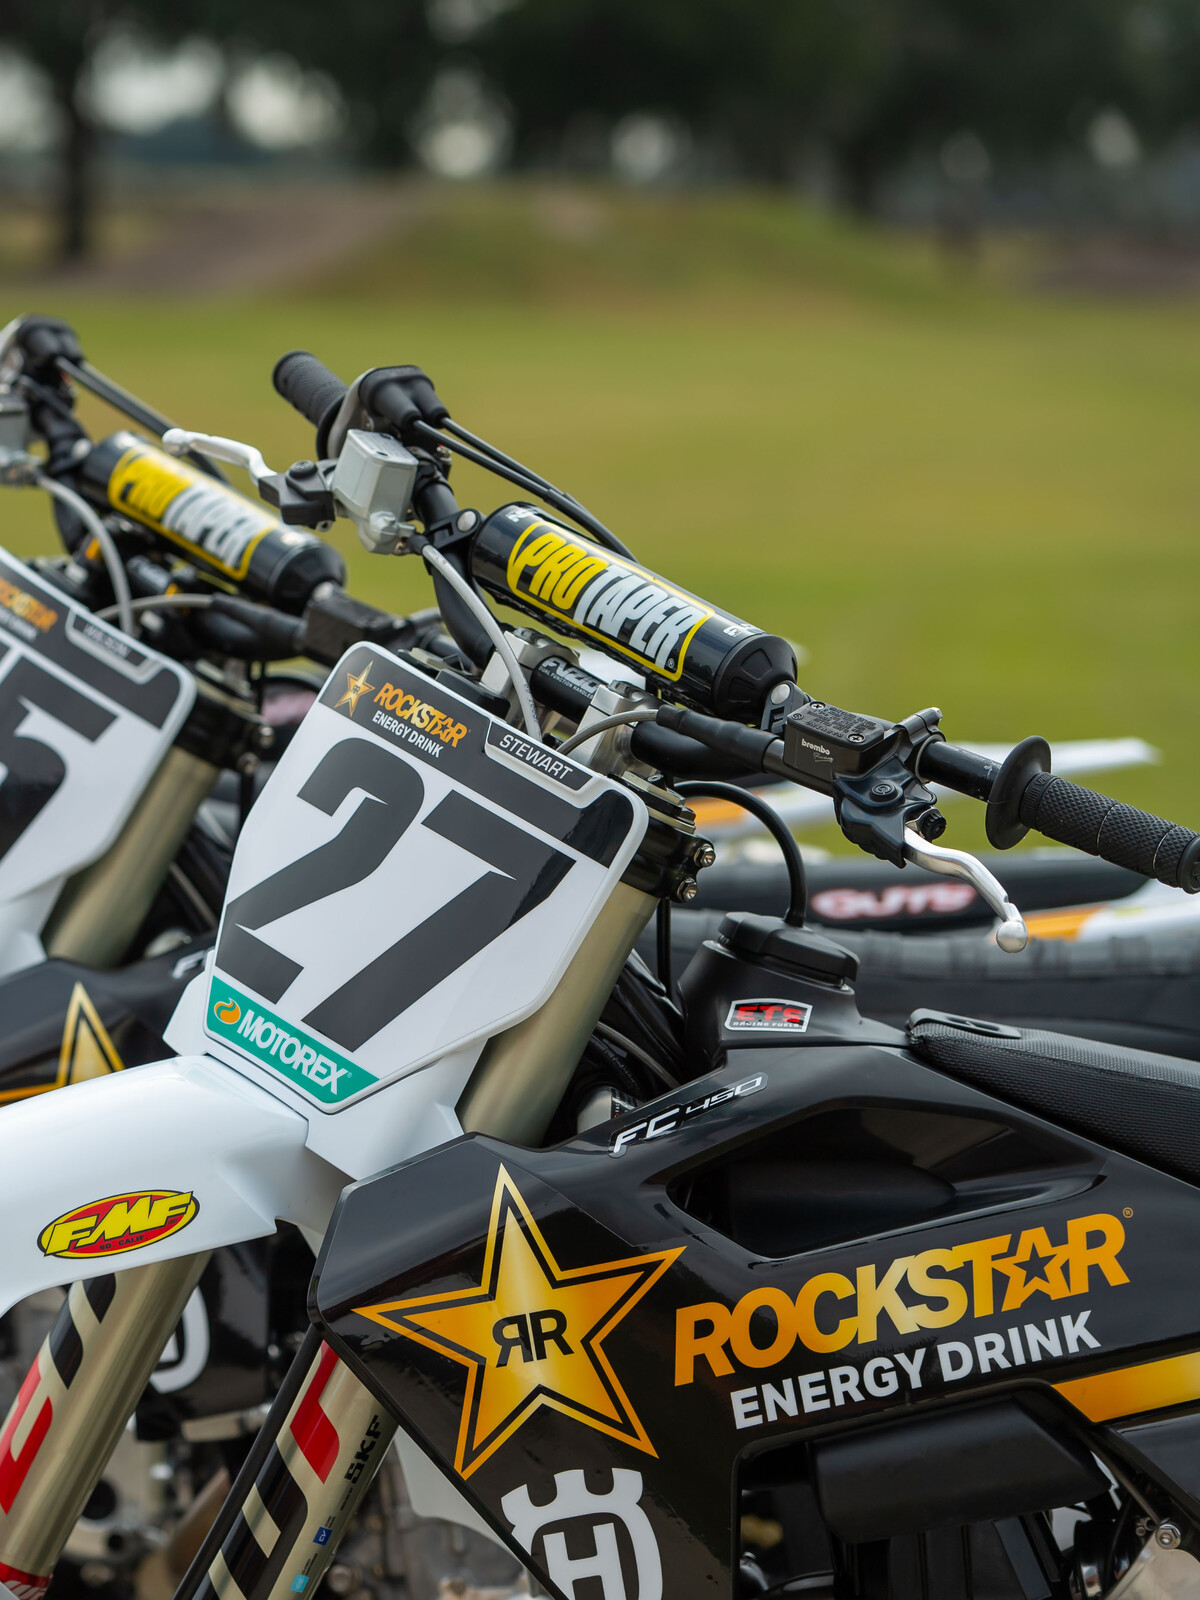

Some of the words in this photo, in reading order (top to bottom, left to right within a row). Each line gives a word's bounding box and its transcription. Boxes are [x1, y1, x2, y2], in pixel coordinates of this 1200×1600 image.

[552, 672, 573, 688] FUNCTION
[372, 709, 411, 742] ENERGY
[407, 731, 444, 758] DRINK
[373, 682, 468, 748] ROCKSTAR
[801, 737, 831, 756] brombo
[499, 733, 573, 780] STEWART
[214, 737, 577, 1053] 27
[736, 1005, 803, 1022] ETS
[237, 1009, 348, 1095] MOTOREX
[613, 1107, 680, 1153] FC
[685, 1076, 763, 1113] 450
[43, 1190, 194, 1257] FMF
[118, 1235, 149, 1247] CALIF.
[673, 1213, 1131, 1387] ROCKSTAR
[730, 1347, 936, 1430] ENERGY
[936, 1310, 1102, 1383] DRINK
[345, 1414, 382, 1484] SKF
